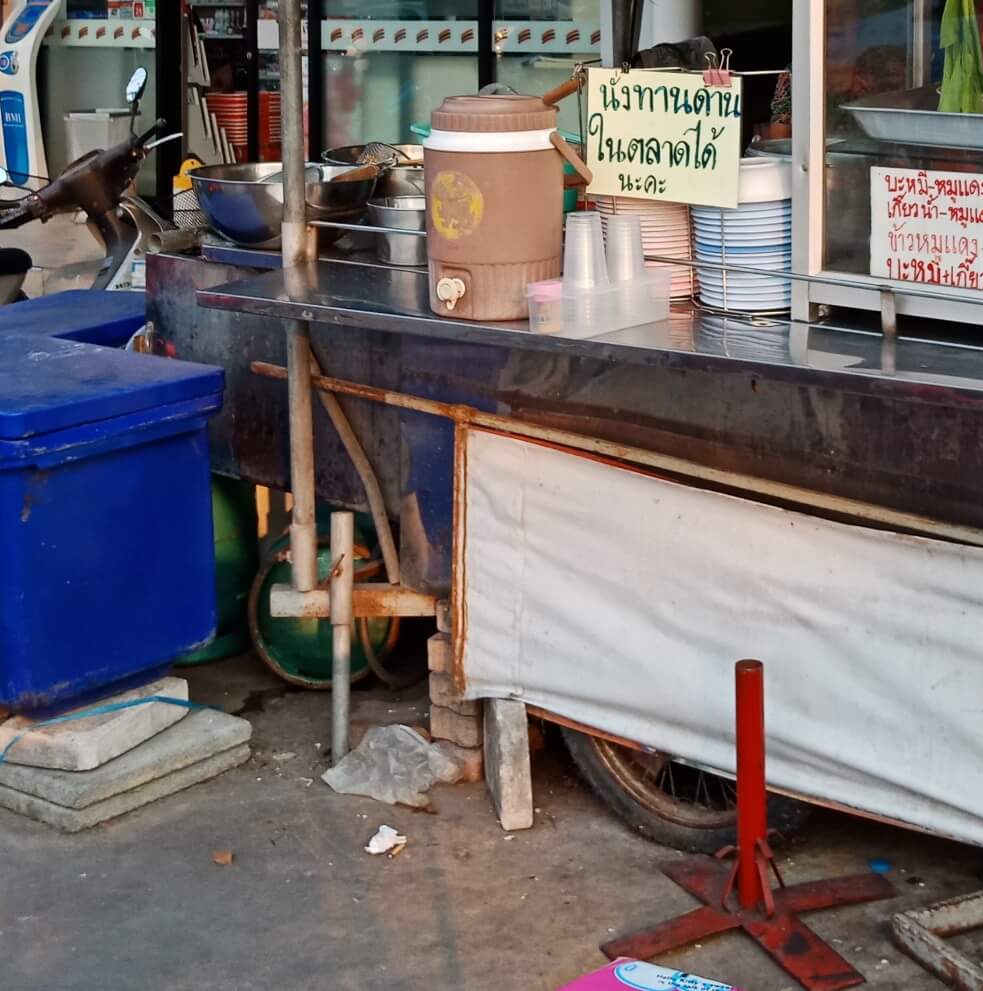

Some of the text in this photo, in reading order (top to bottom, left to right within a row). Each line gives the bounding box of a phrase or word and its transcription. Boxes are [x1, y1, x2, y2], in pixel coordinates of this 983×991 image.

[599, 70, 742, 118] นั่งทานดาน
[588, 112, 726, 170] ในตลาดได้
[618, 173, 667, 195] นะคะ
